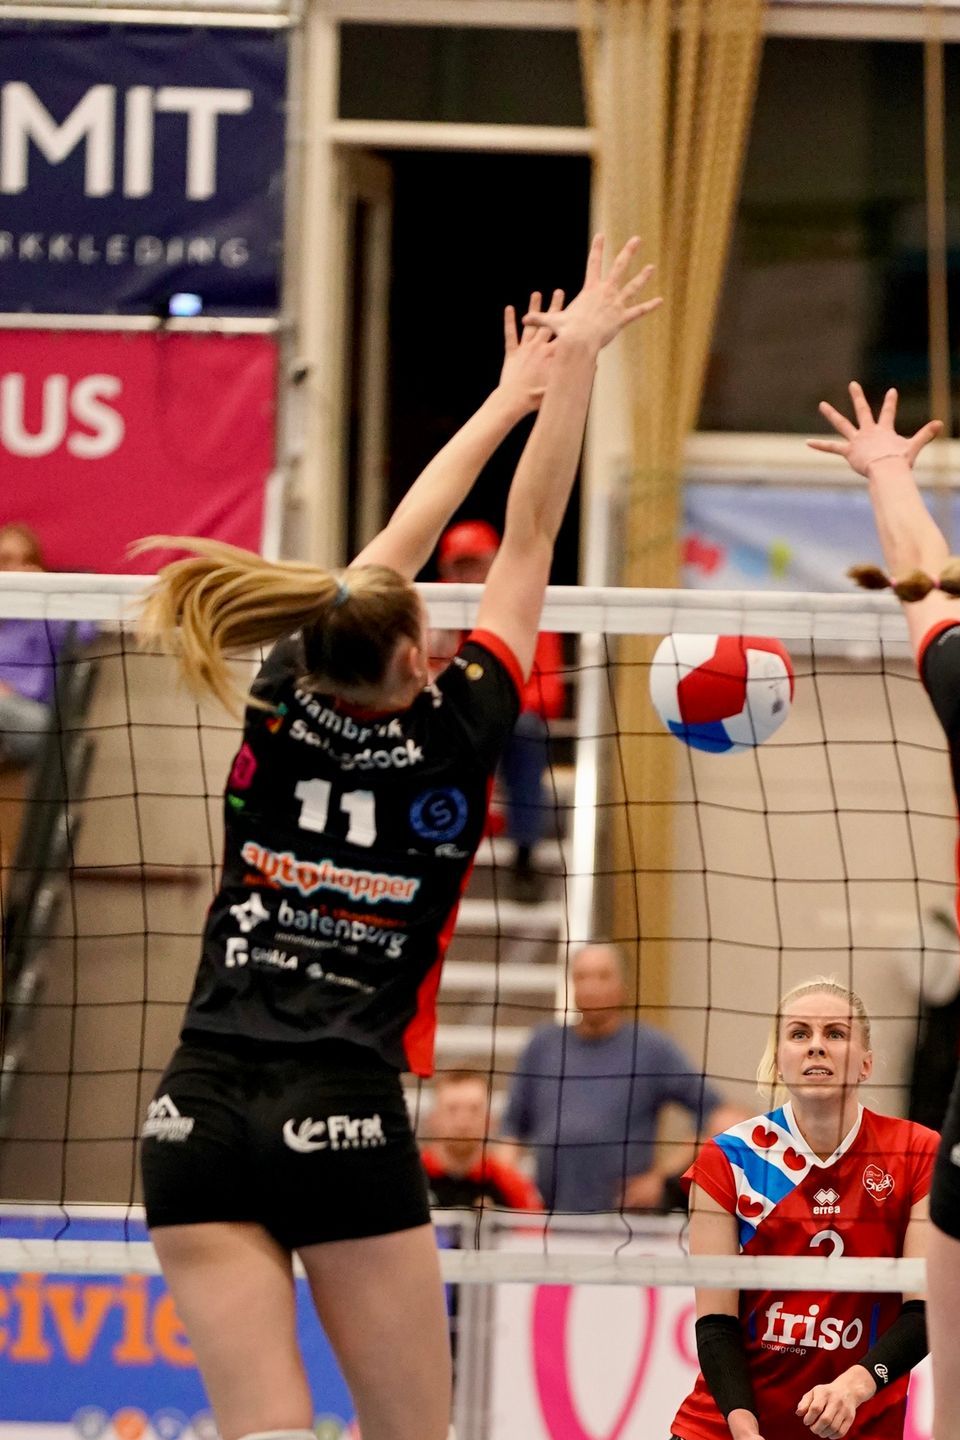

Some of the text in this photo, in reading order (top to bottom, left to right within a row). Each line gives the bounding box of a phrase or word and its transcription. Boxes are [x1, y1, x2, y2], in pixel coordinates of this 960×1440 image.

[0, 81, 253, 199] MIT
[0, 372, 126, 460] US
[294, 778, 378, 848] 11
[762, 1301, 863, 1351] friso
